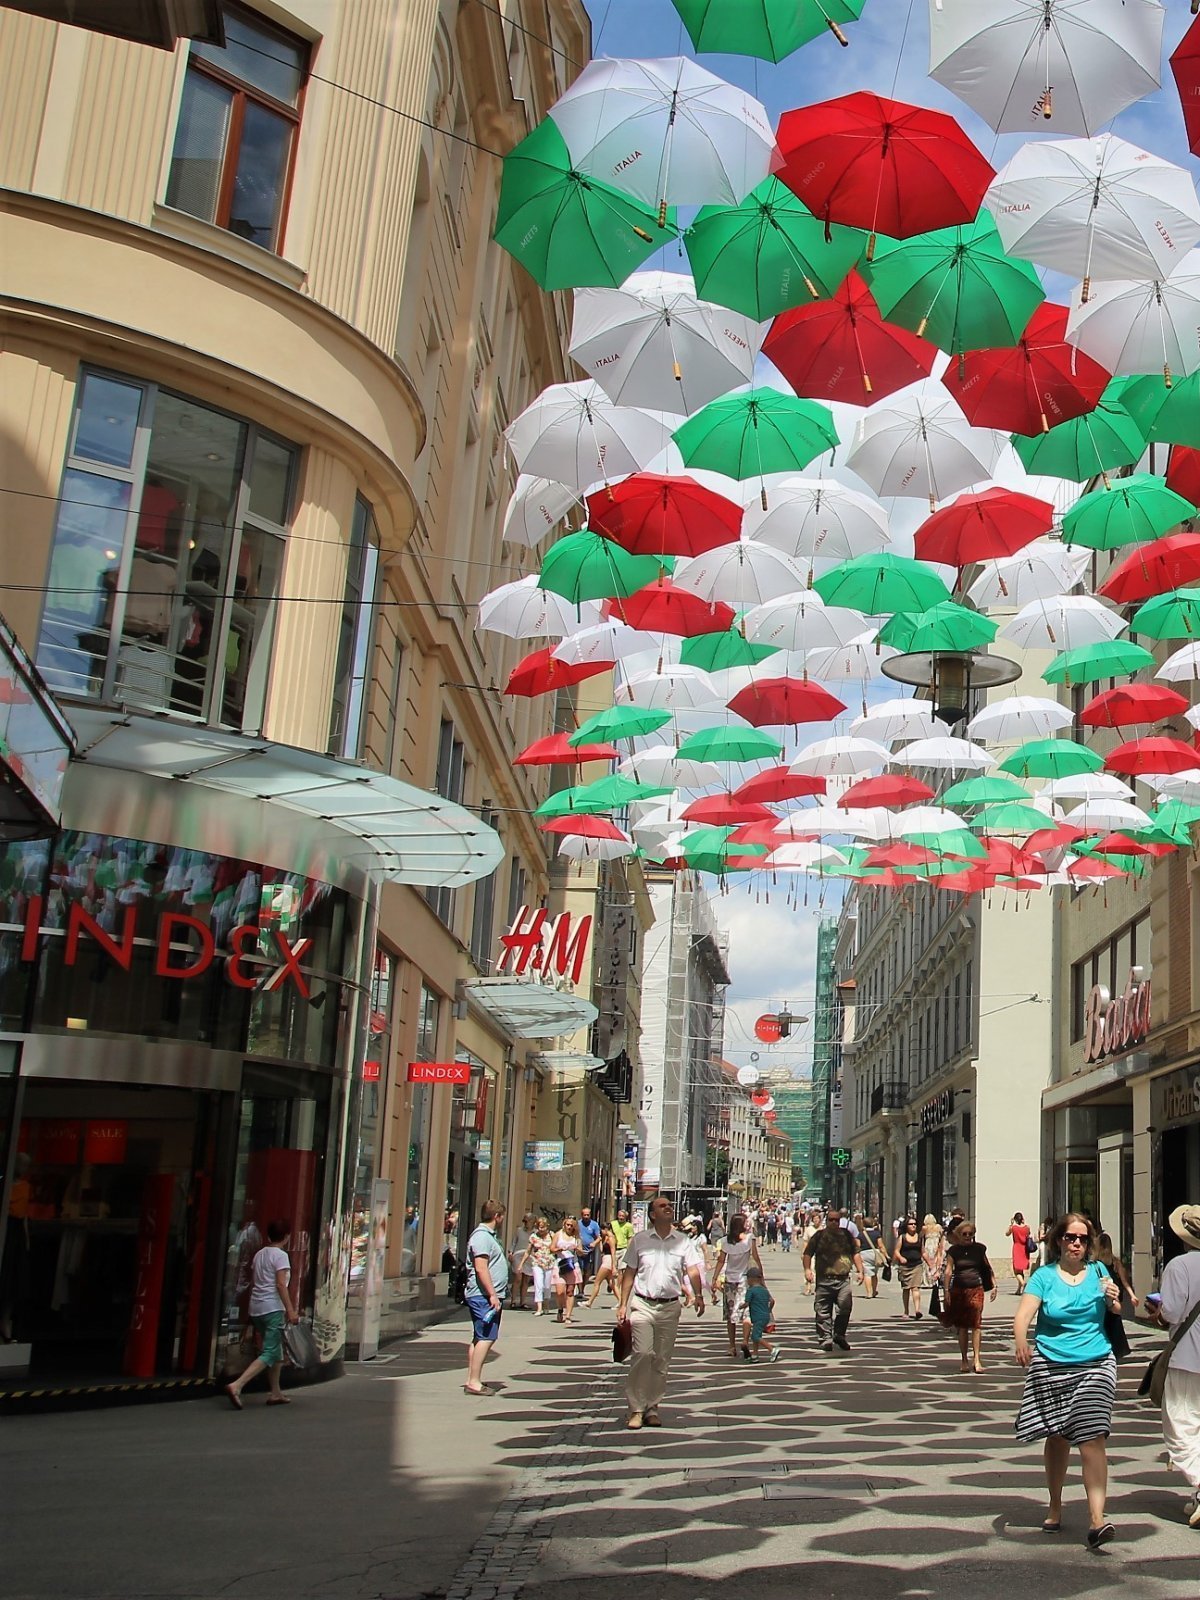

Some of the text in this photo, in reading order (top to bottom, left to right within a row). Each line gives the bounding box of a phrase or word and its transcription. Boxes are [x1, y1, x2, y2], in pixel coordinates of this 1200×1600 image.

[613, 150, 643, 174] ITALIA
[803, 161, 825, 186] BRNO
[1004, 203, 1031, 214] ITALIA
[520, 225, 538, 248] MEETS
[1154, 220, 1175, 249] MEETS
[723, 328, 747, 349] MEETS
[594, 353, 621, 368] ITALIA
[961, 373, 981, 393] MEETS
[1044, 392, 1062, 413] BRNO
[901, 465, 918, 489] ITALIA
[539, 504, 554, 525] BRNO
[816, 528, 829, 549] ITALIA
[496, 905, 592, 985] H&M
[412, 1068, 464, 1079] LINDEX
[91, 1126, 123, 1139] SALE
